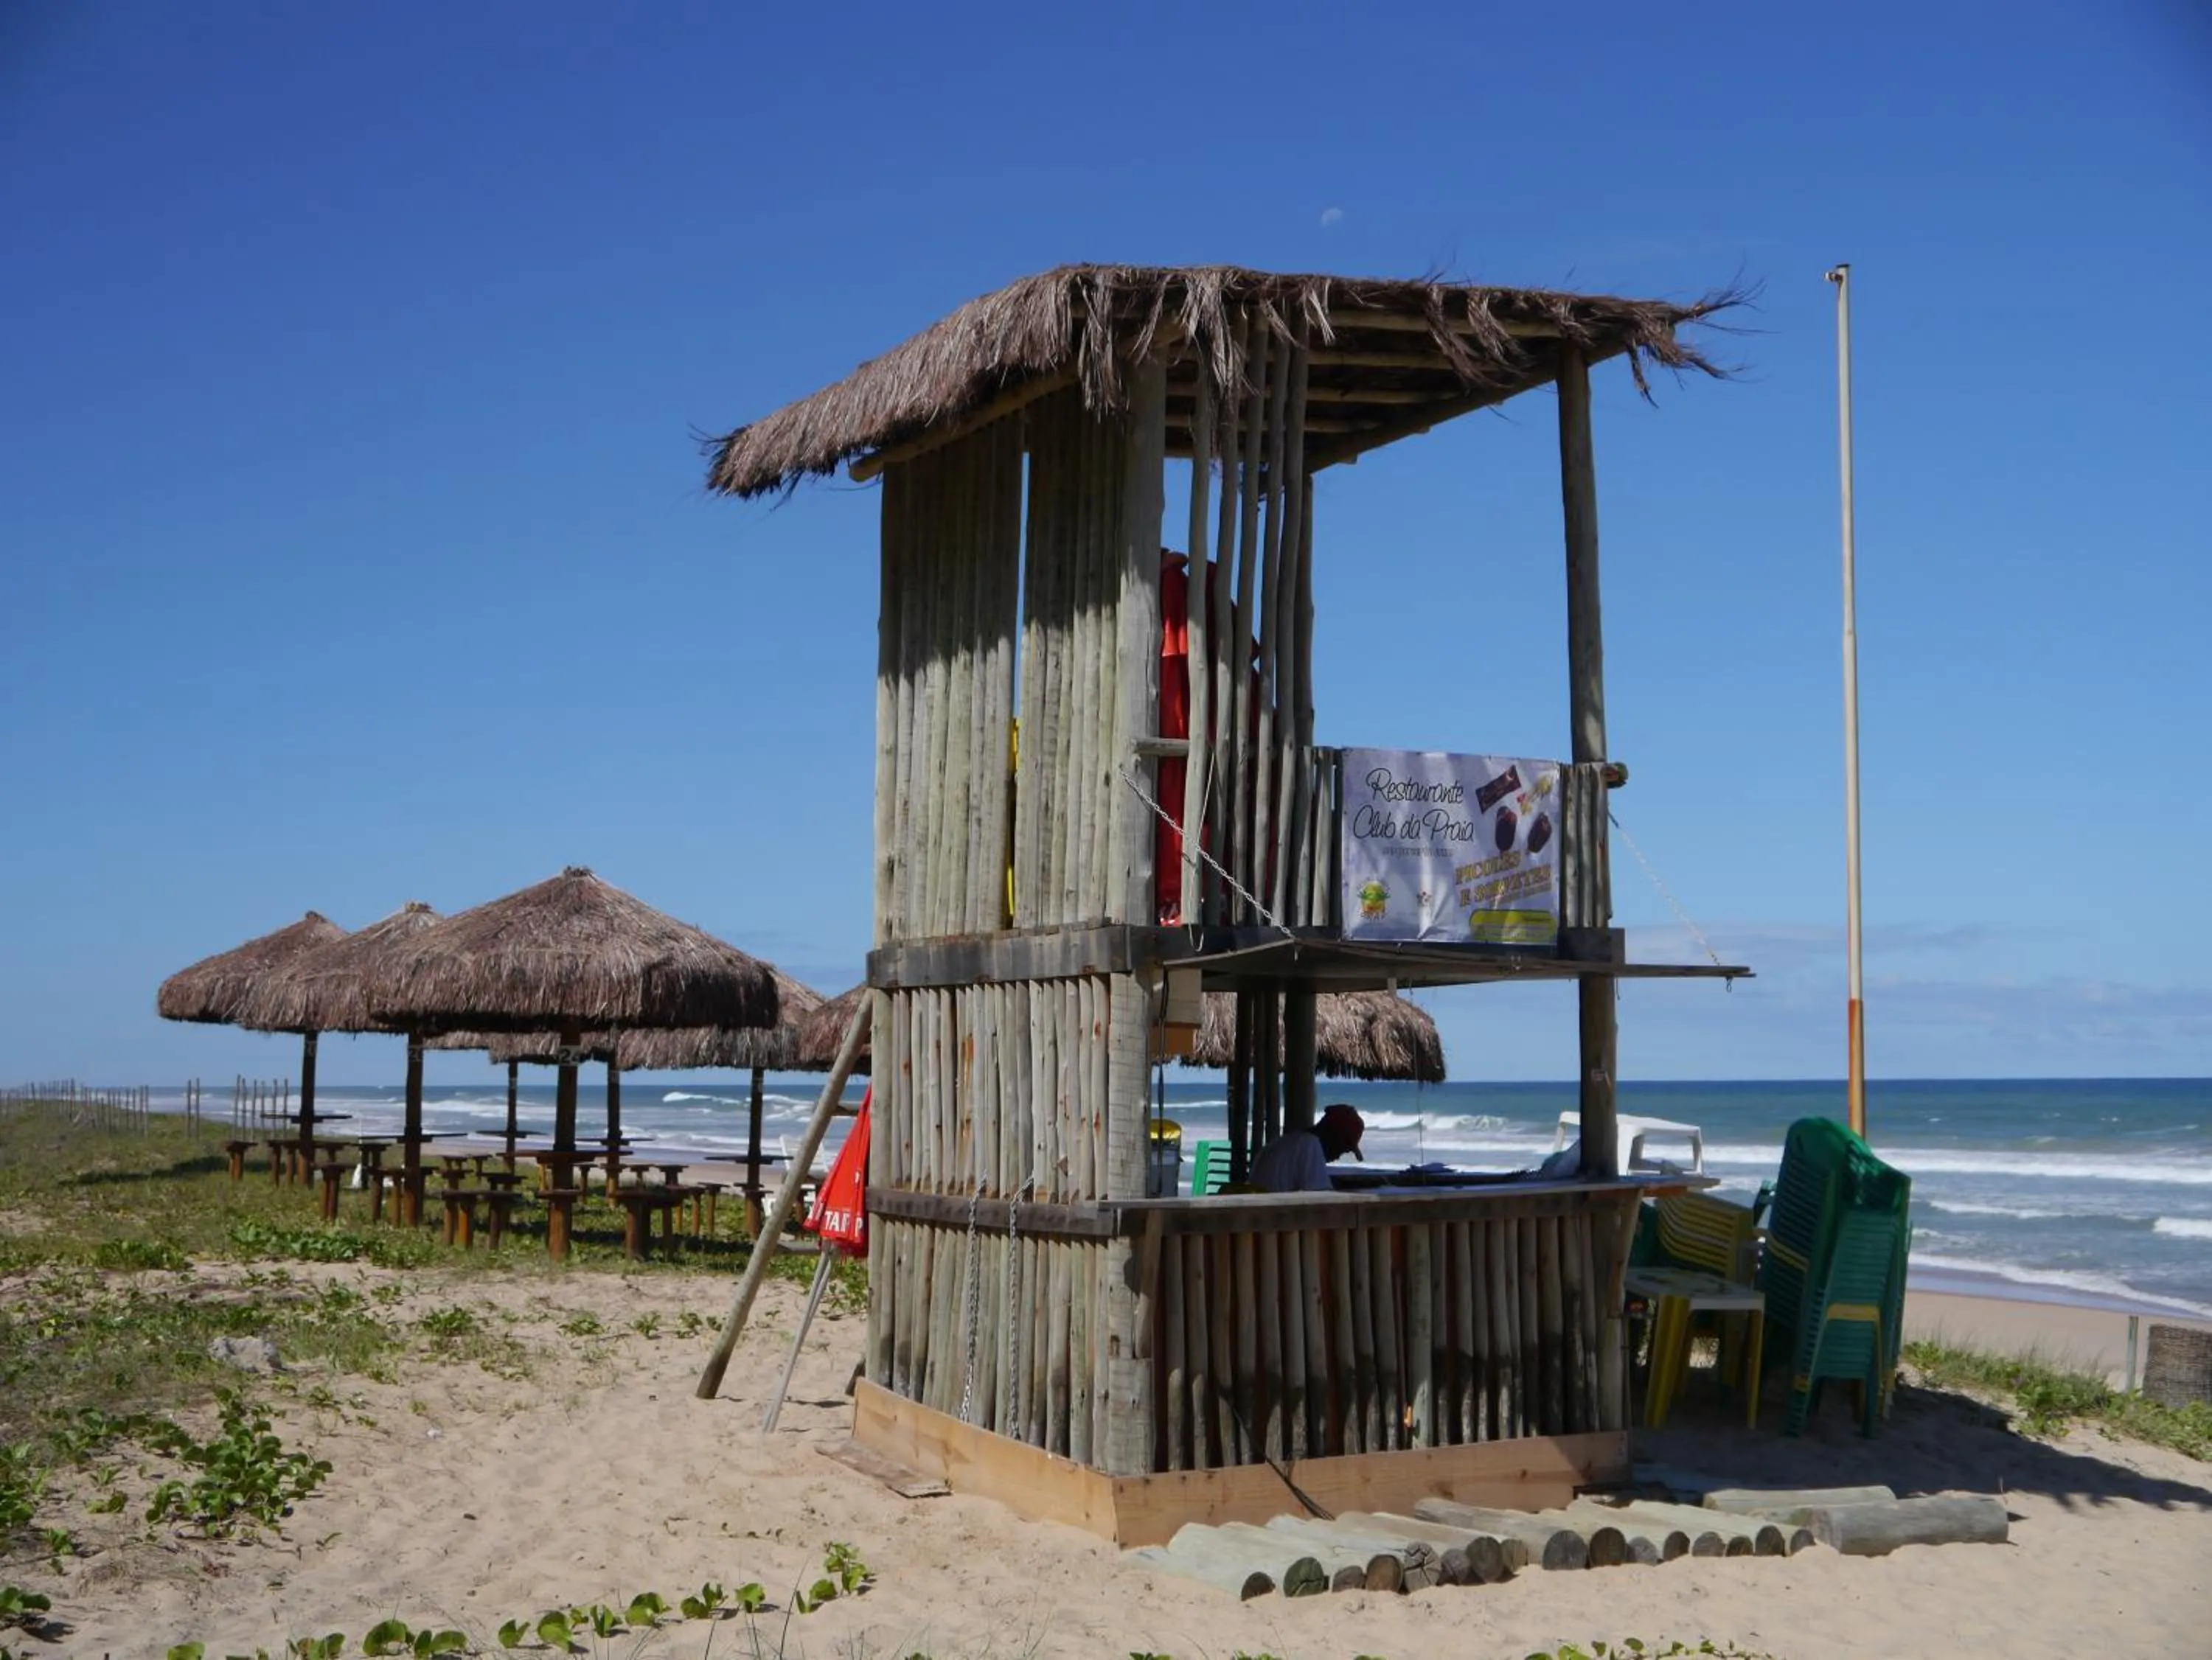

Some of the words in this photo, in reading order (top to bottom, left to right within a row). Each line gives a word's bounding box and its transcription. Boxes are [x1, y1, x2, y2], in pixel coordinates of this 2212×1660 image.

[1366, 767, 1464, 804] Restaurante
[1353, 804, 1396, 840] Club
[1422, 809, 1474, 842] Praia
